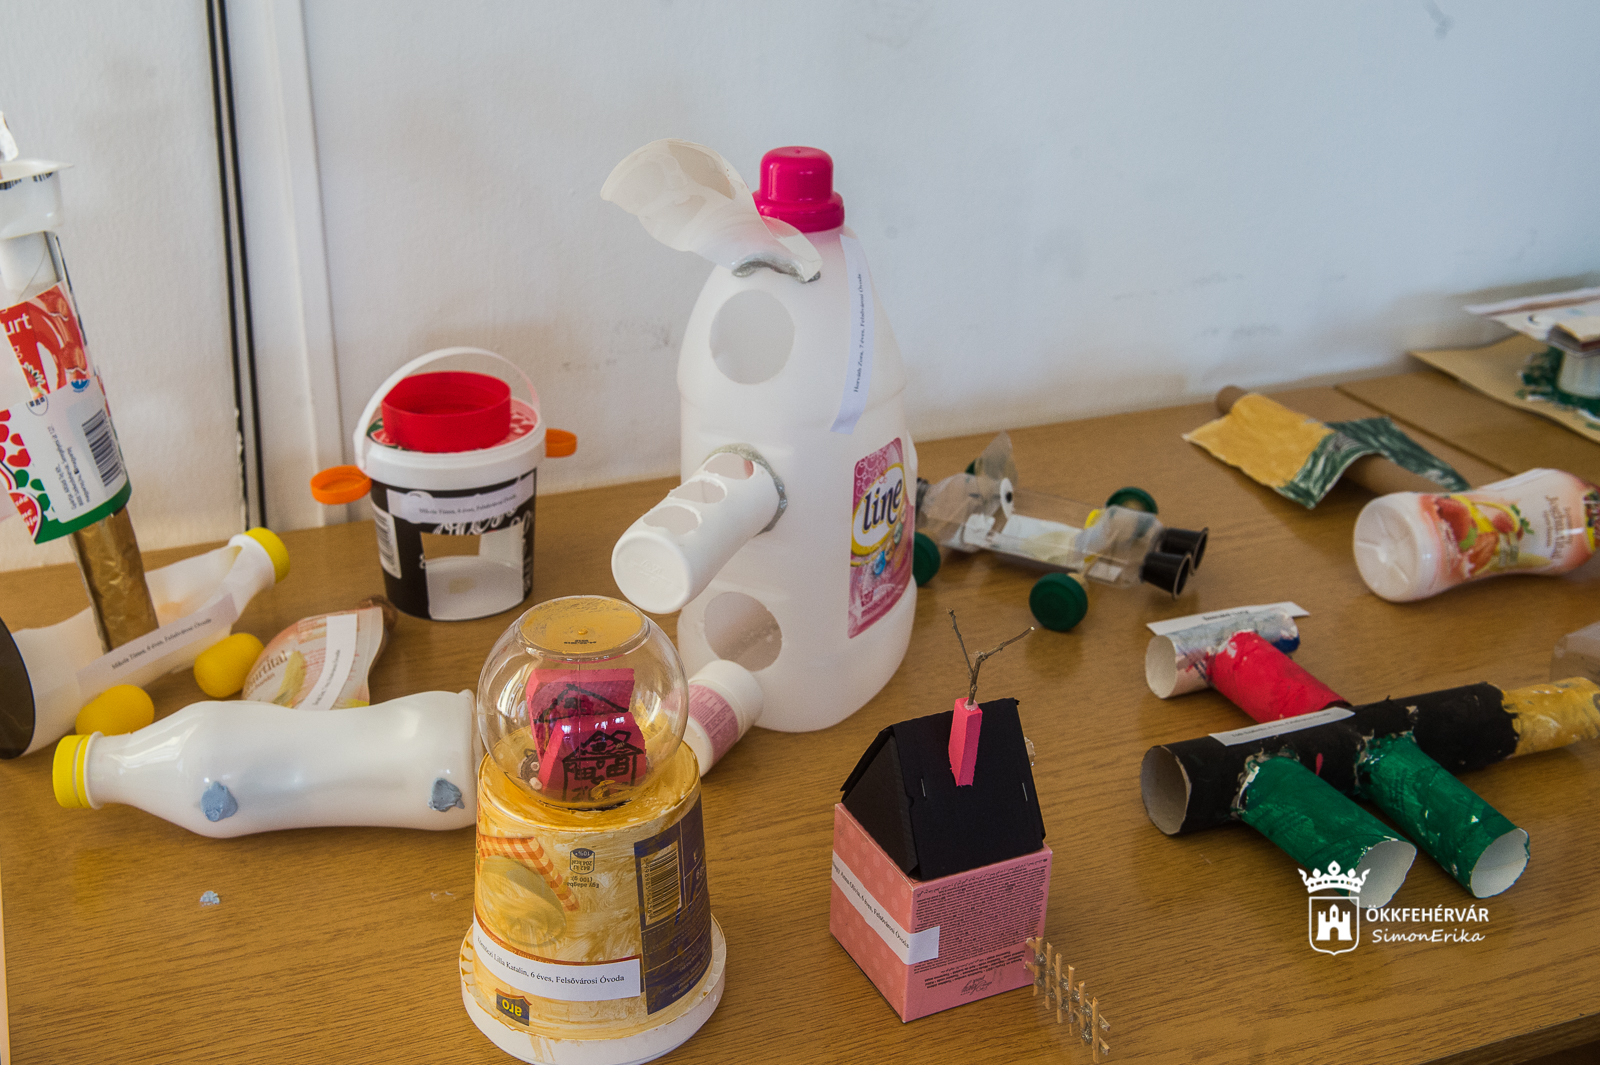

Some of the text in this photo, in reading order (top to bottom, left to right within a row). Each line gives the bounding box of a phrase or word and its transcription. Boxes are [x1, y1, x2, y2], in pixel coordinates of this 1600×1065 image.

[506, 961, 529, 977] Katalin,
[536, 973, 554, 983] éves,
[555, 976, 598, 985] Felsővárosi
[599, 975, 625, 984] Óvoda
[501, 999, 522, 1017] aro
